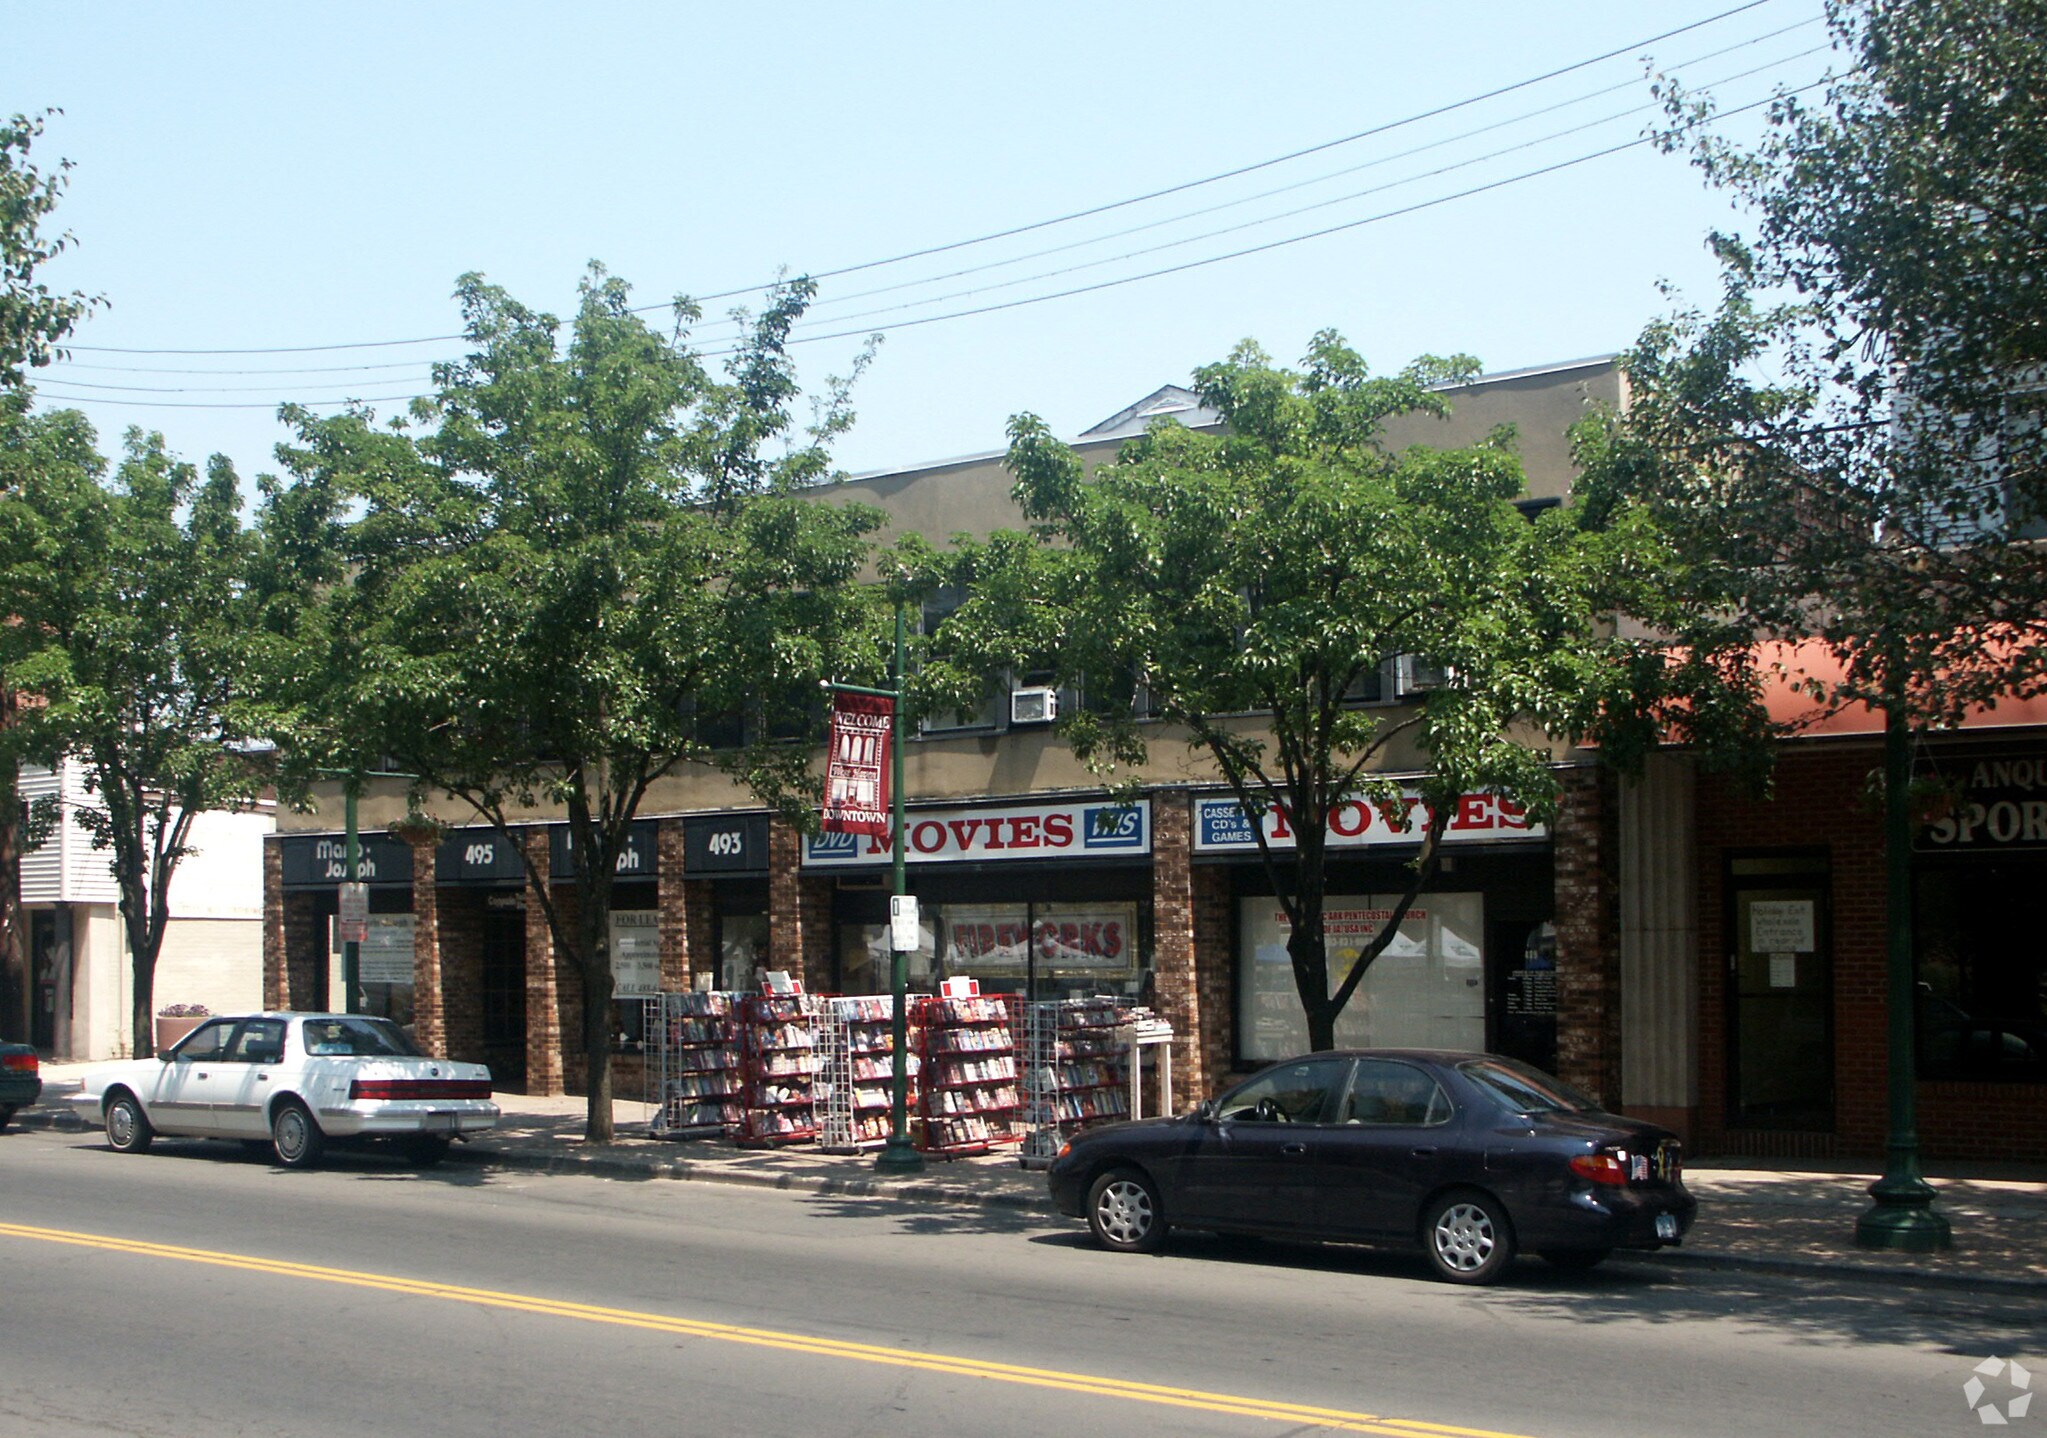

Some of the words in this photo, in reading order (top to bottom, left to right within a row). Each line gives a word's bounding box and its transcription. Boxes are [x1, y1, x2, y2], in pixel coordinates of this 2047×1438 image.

[834, 711, 891, 729] WELCOME
[823, 808, 887, 824] DOWNTOWN
[1211, 818, 1237, 830] CD's
[1241, 818, 1251, 829] &
[813, 831, 854, 849] DVD
[866, 813, 1074, 854] MOVIES
[1211, 831, 1252, 842] GAMES
[708, 832, 742, 855] 493
[465, 843, 494, 864] 495
[325, 857, 376, 878] Joph
[1344, 910, 1393, 920] PENTECOSTAL
